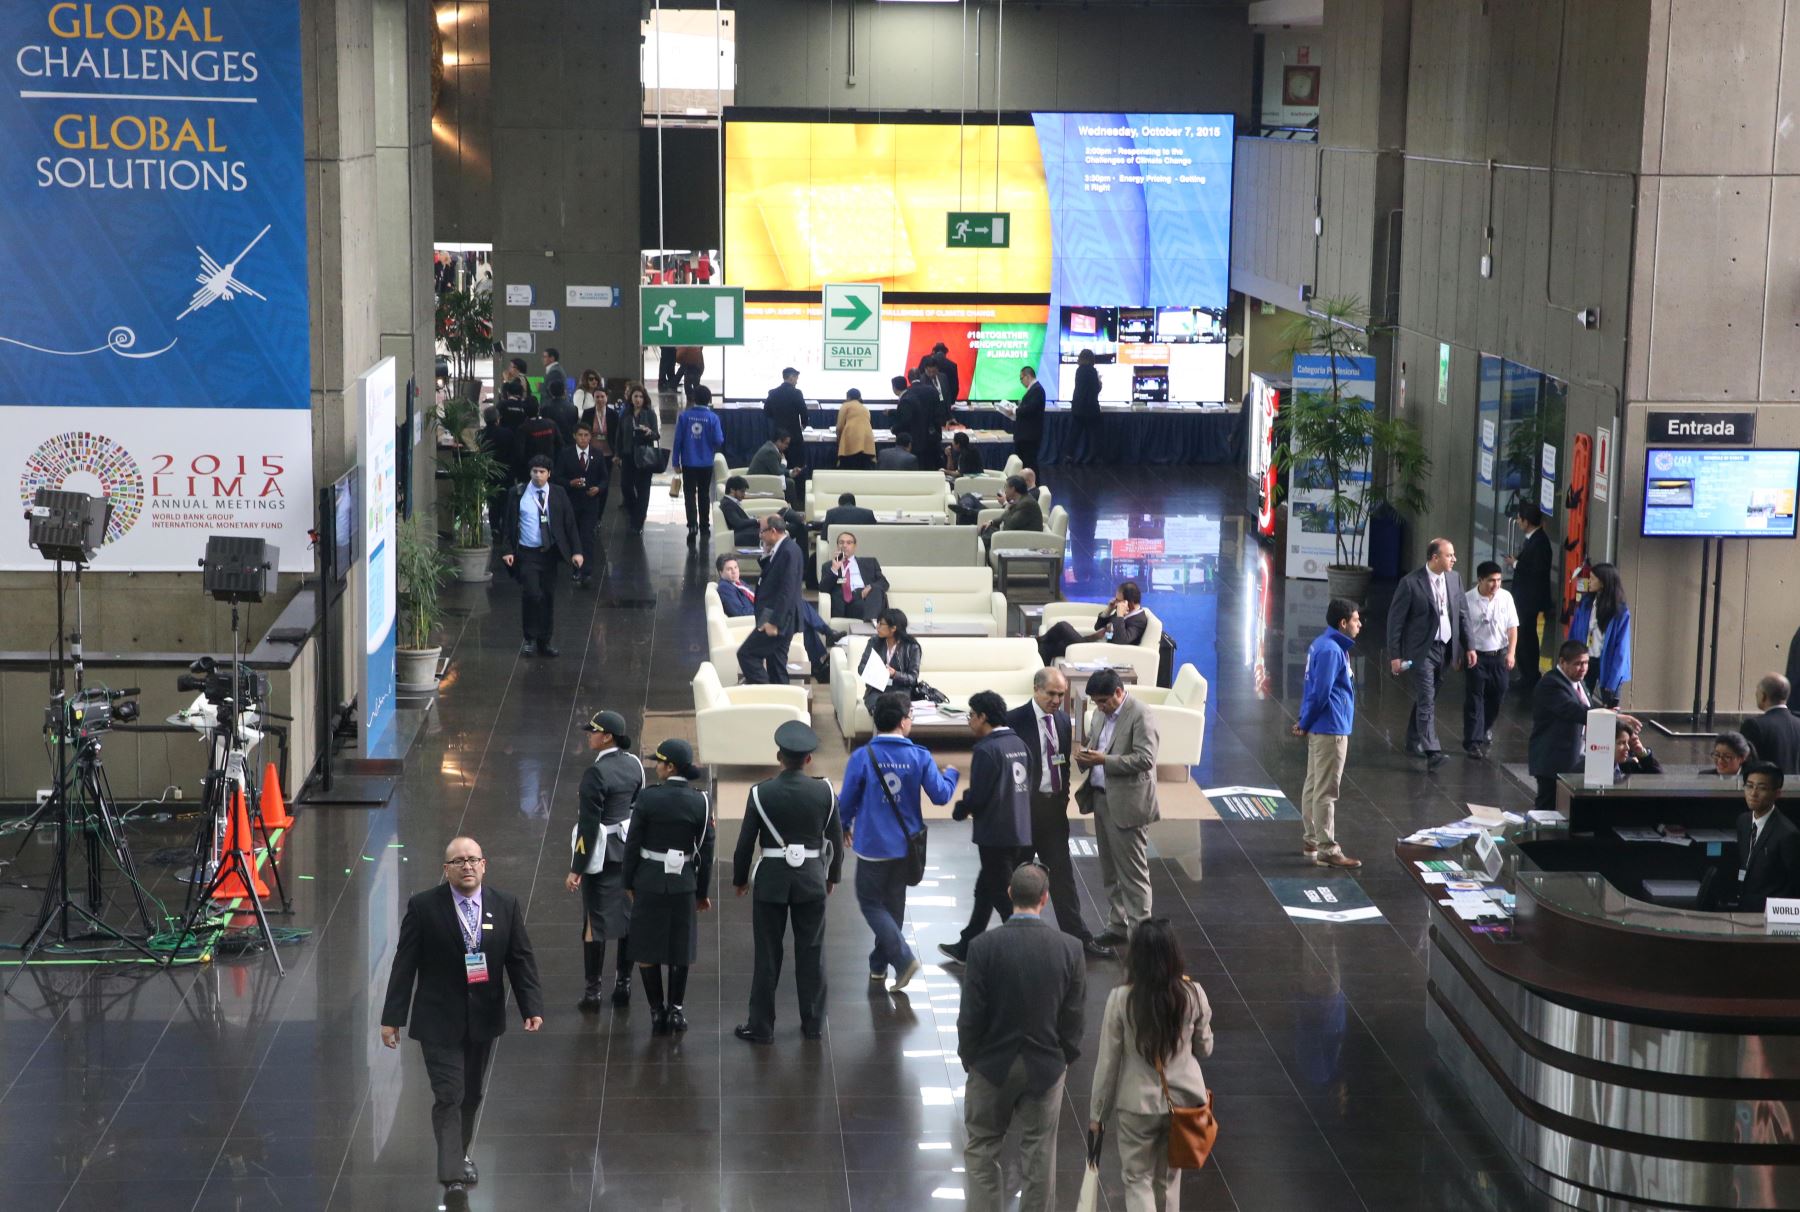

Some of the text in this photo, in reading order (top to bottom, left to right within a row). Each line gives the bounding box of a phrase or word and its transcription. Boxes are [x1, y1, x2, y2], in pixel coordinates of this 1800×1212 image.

[48, 2, 223, 42] GLOBAL
[16, 45, 258, 82] CHALLENGES
[53, 113, 228, 152] GLOBAL
[1141, 126, 1182, 137] October
[36, 157, 248, 192] SOLUTIONS
[831, 346, 872, 355] SALIDA
[840, 359, 864, 367] EXIT
[1668, 420, 1735, 435] Entrada
[152, 454, 284, 476] 2015
[152, 476, 284, 497] LIMA
[152, 499, 285, 509] ANNUAL MEETINGS
[152, 521, 213, 529] INTERNATIONAL
[1772, 906, 1800, 915] WORLD
